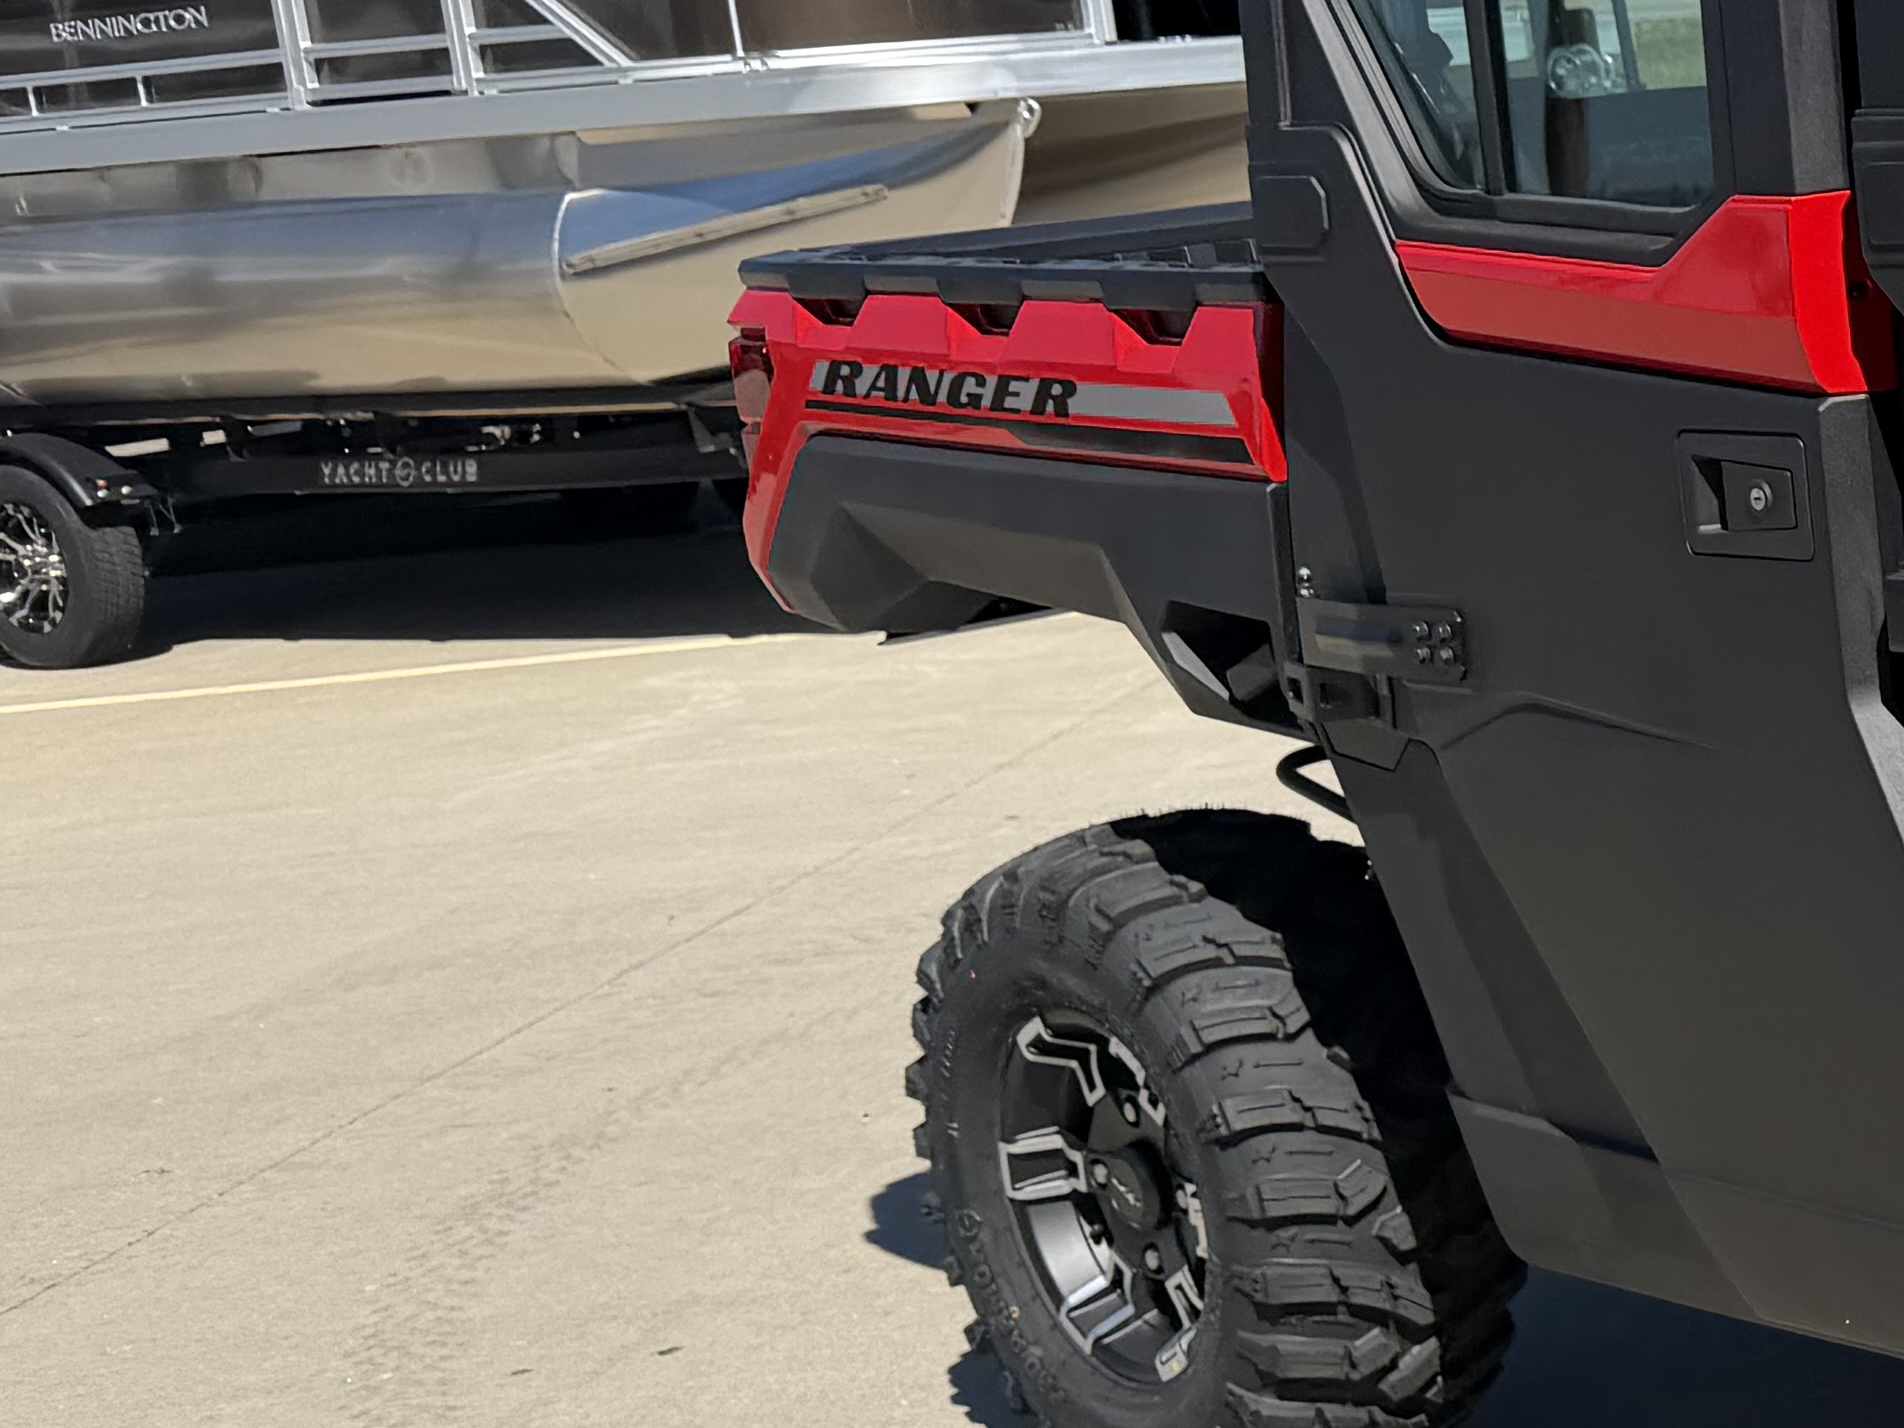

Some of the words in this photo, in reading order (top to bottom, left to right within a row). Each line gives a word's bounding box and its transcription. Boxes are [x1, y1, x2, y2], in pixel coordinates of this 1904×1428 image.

[49, 5, 210, 44] BENNINGTON
[820, 359, 1078, 419] RANGER
[320, 459, 391, 485] YACHT
[421, 458, 479, 483] CLUB
